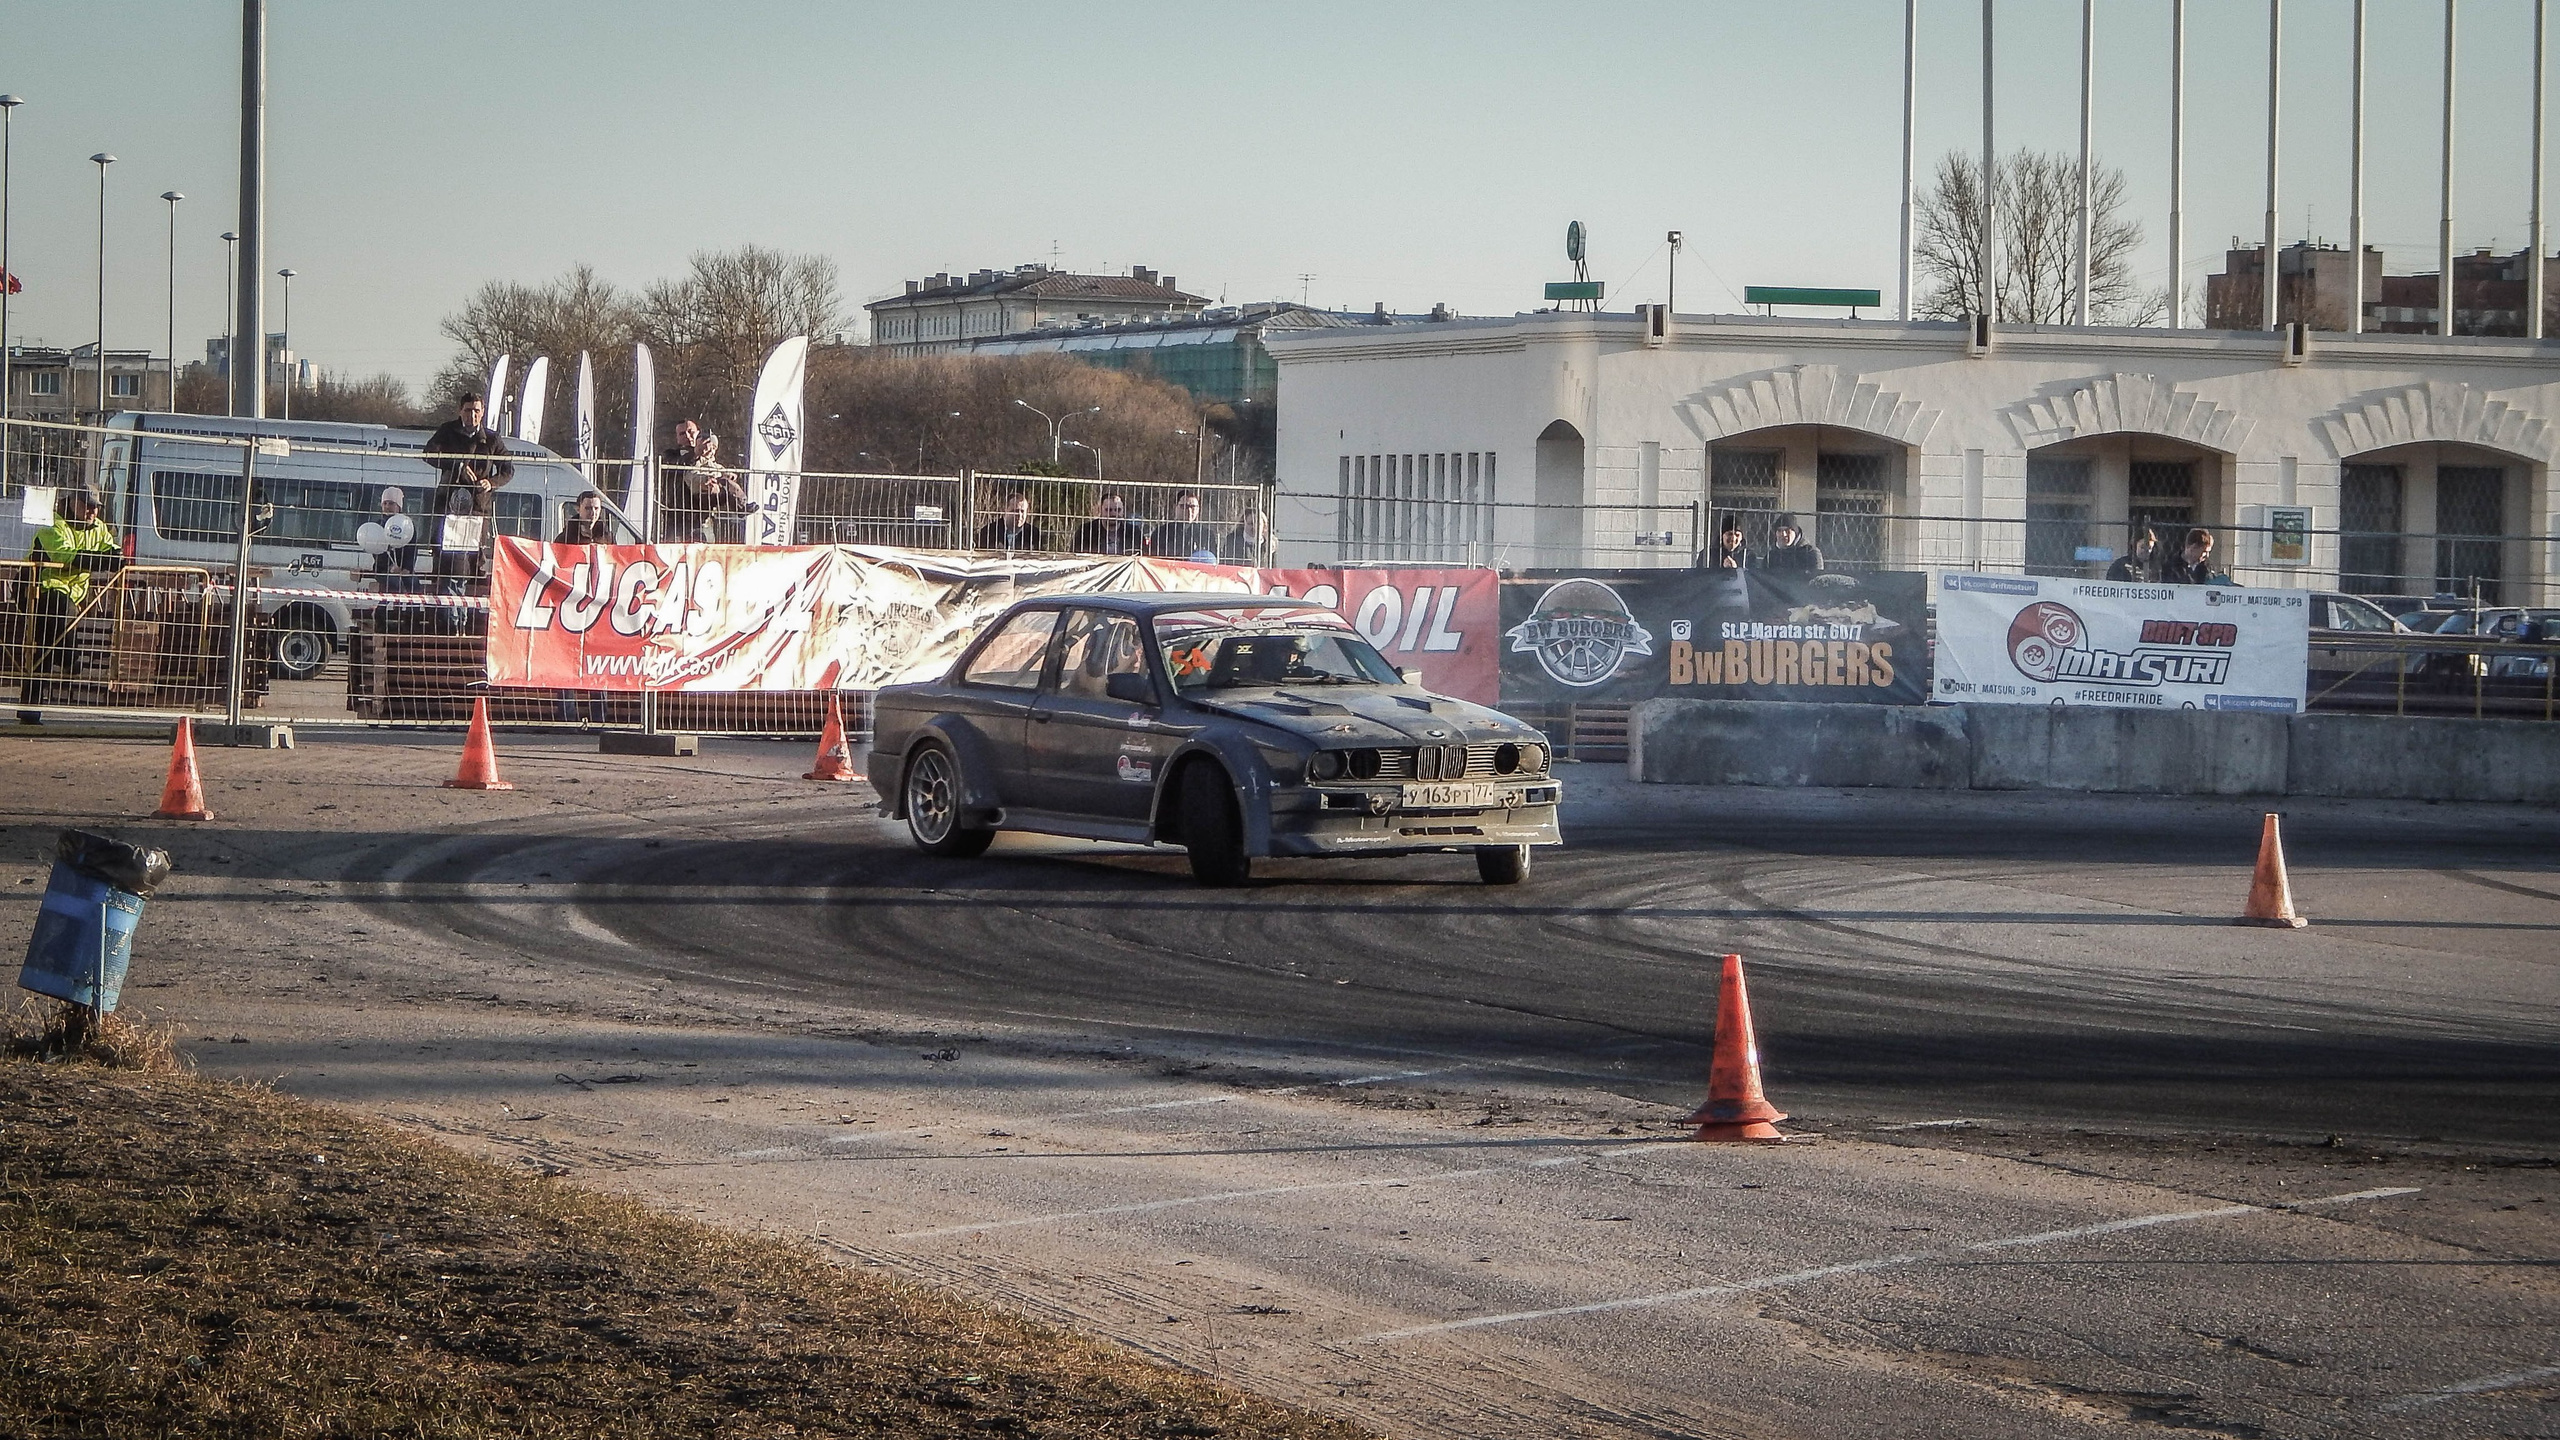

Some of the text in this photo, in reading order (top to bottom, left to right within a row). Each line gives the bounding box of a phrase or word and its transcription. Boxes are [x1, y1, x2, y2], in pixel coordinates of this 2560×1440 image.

[515, 560, 726, 636] LUCAS
[2073, 585, 2175, 600] #FREEDRIFTSESSION
[1354, 585, 1464, 652] OIL
[1527, 621, 1634, 639] BW BURGERS
[1751, 622, 1802, 639] Marata
[1805, 624, 1827, 639] str.
[1829, 624, 1862, 640] 60/7
[2139, 620, 2238, 647] DRIFT SPB
[1670, 640, 1895, 688] BwBURGERS
[2056, 648, 2232, 687] MATSURI
[2074, 690, 2163, 705] #FREEDRIFTRIDE
